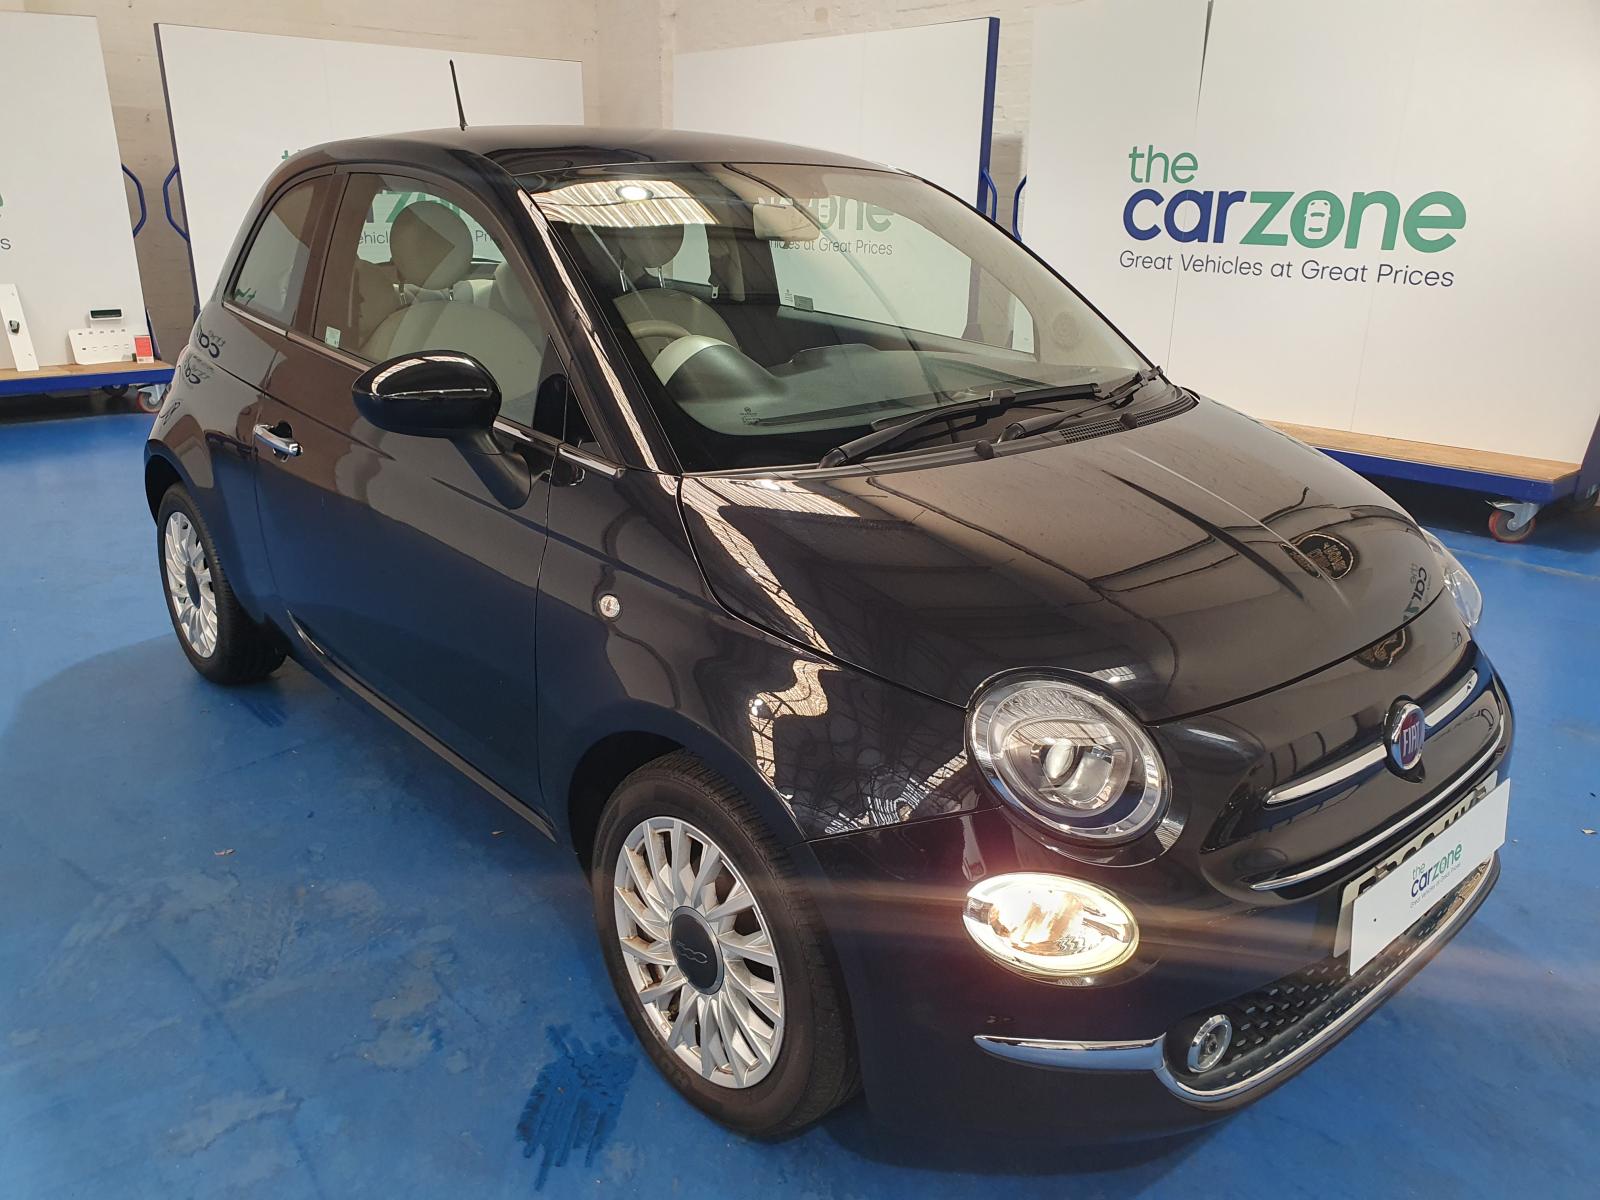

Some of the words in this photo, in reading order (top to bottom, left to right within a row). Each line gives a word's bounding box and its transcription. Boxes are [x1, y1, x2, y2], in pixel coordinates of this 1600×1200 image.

[1128, 144, 1199, 184] the
[1122, 188, 1467, 253] carzone
[818, 237, 852, 253] Great
[855, 239, 893, 256] Prices
[1119, 250, 1173, 271] Great
[1180, 253, 1263, 276] Vehicles
[1270, 261, 1293, 279] at
[1301, 259, 1368, 283] Great
[1377, 263, 1455, 287] Prices
[1402, 721, 1420, 757] FIAT
[1411, 843, 1463, 898] carzone
